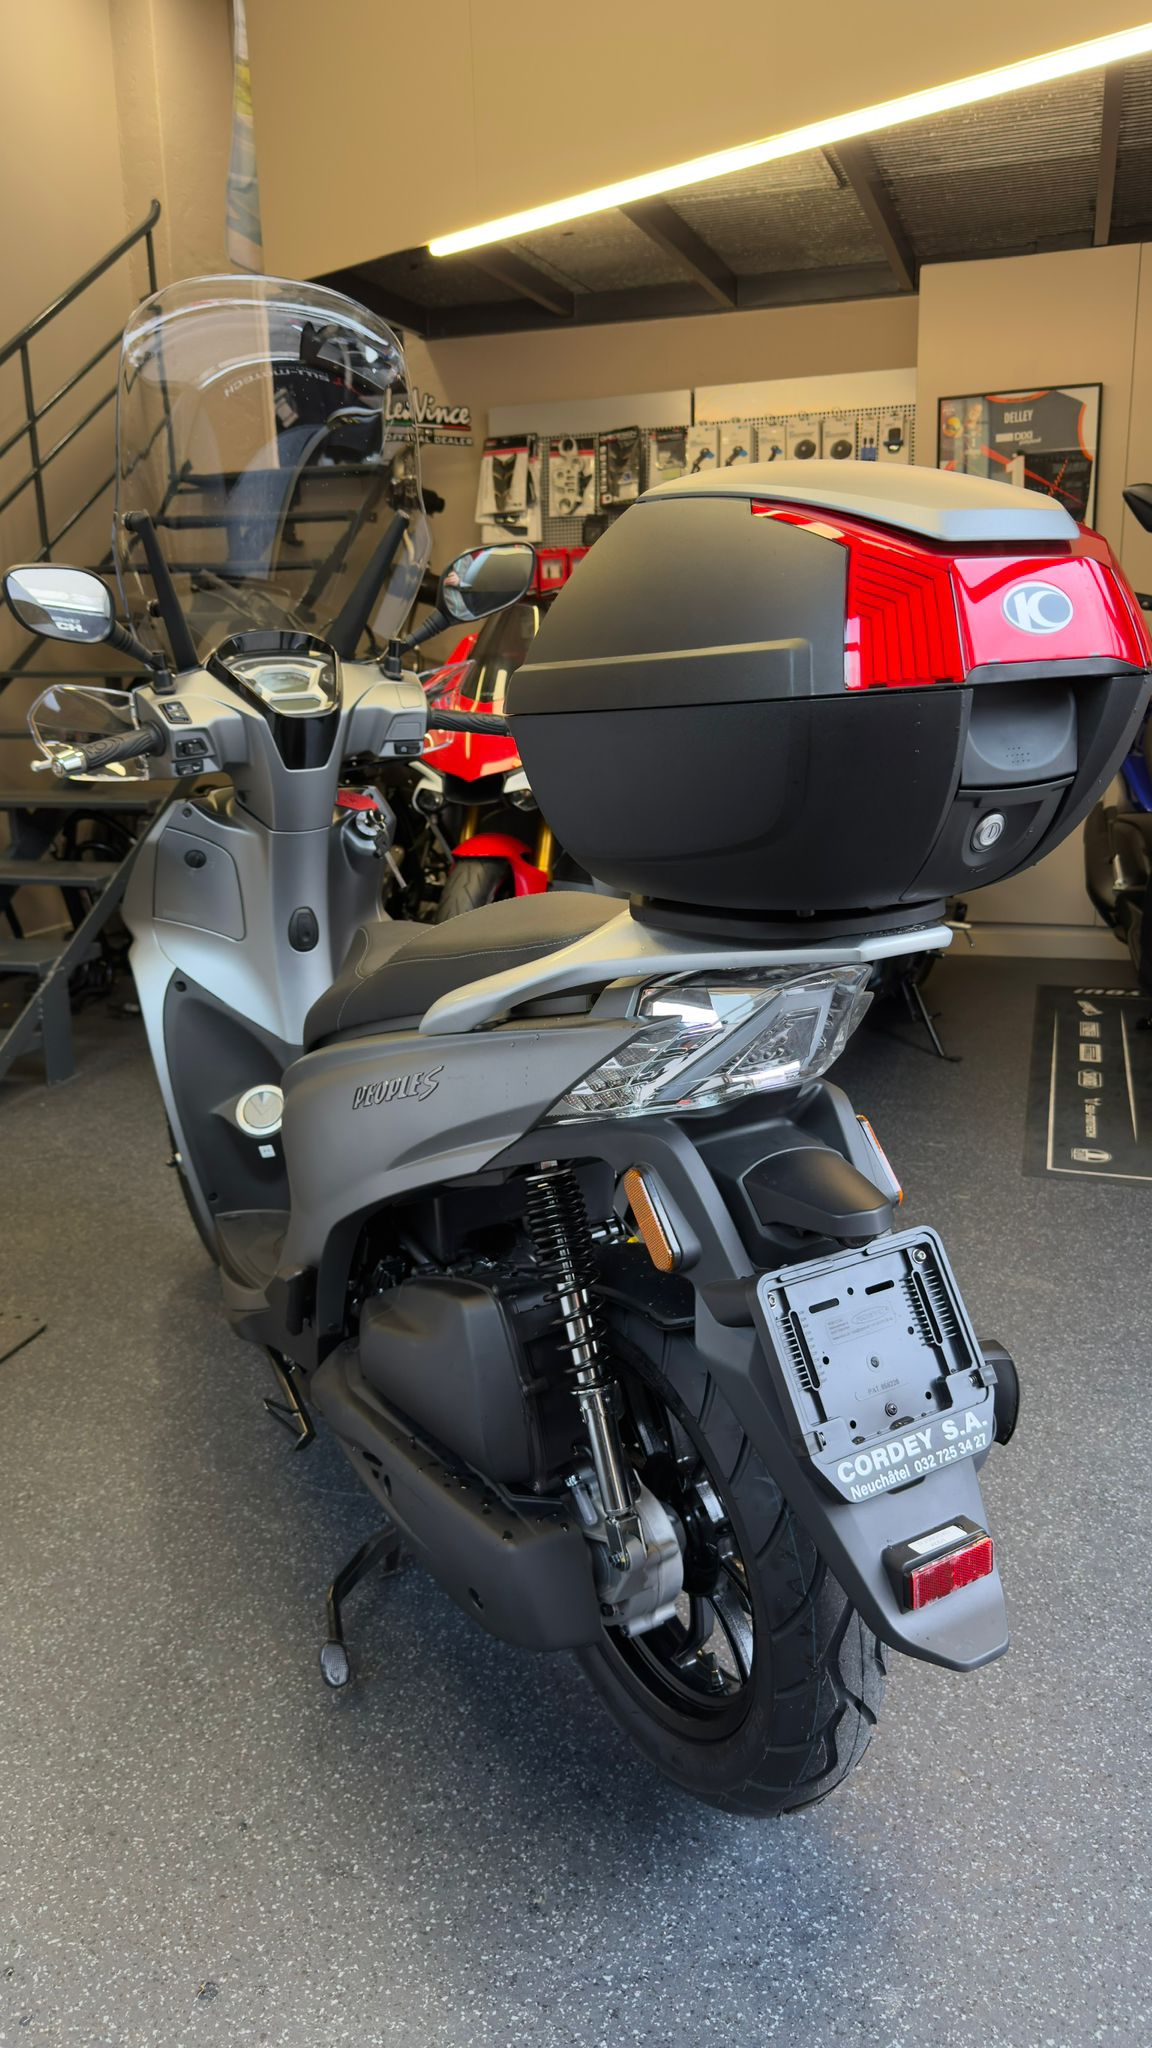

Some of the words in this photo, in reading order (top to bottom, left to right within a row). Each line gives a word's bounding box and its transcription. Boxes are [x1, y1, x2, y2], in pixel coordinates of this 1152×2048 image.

[1004, 409, 1033, 424] DELLEY
[433, 437, 473, 445] DEALER
[837, 1428, 933, 1484] CORDEY
[941, 1411, 988, 1441] S.A.
[850, 1463, 911, 1500] Neuchâtel
[914, 1453, 937, 1473] 032
[936, 1446, 958, 1464] 725
[957, 1441, 973, 1456] 34
[973, 1433, 987, 1447] 27
